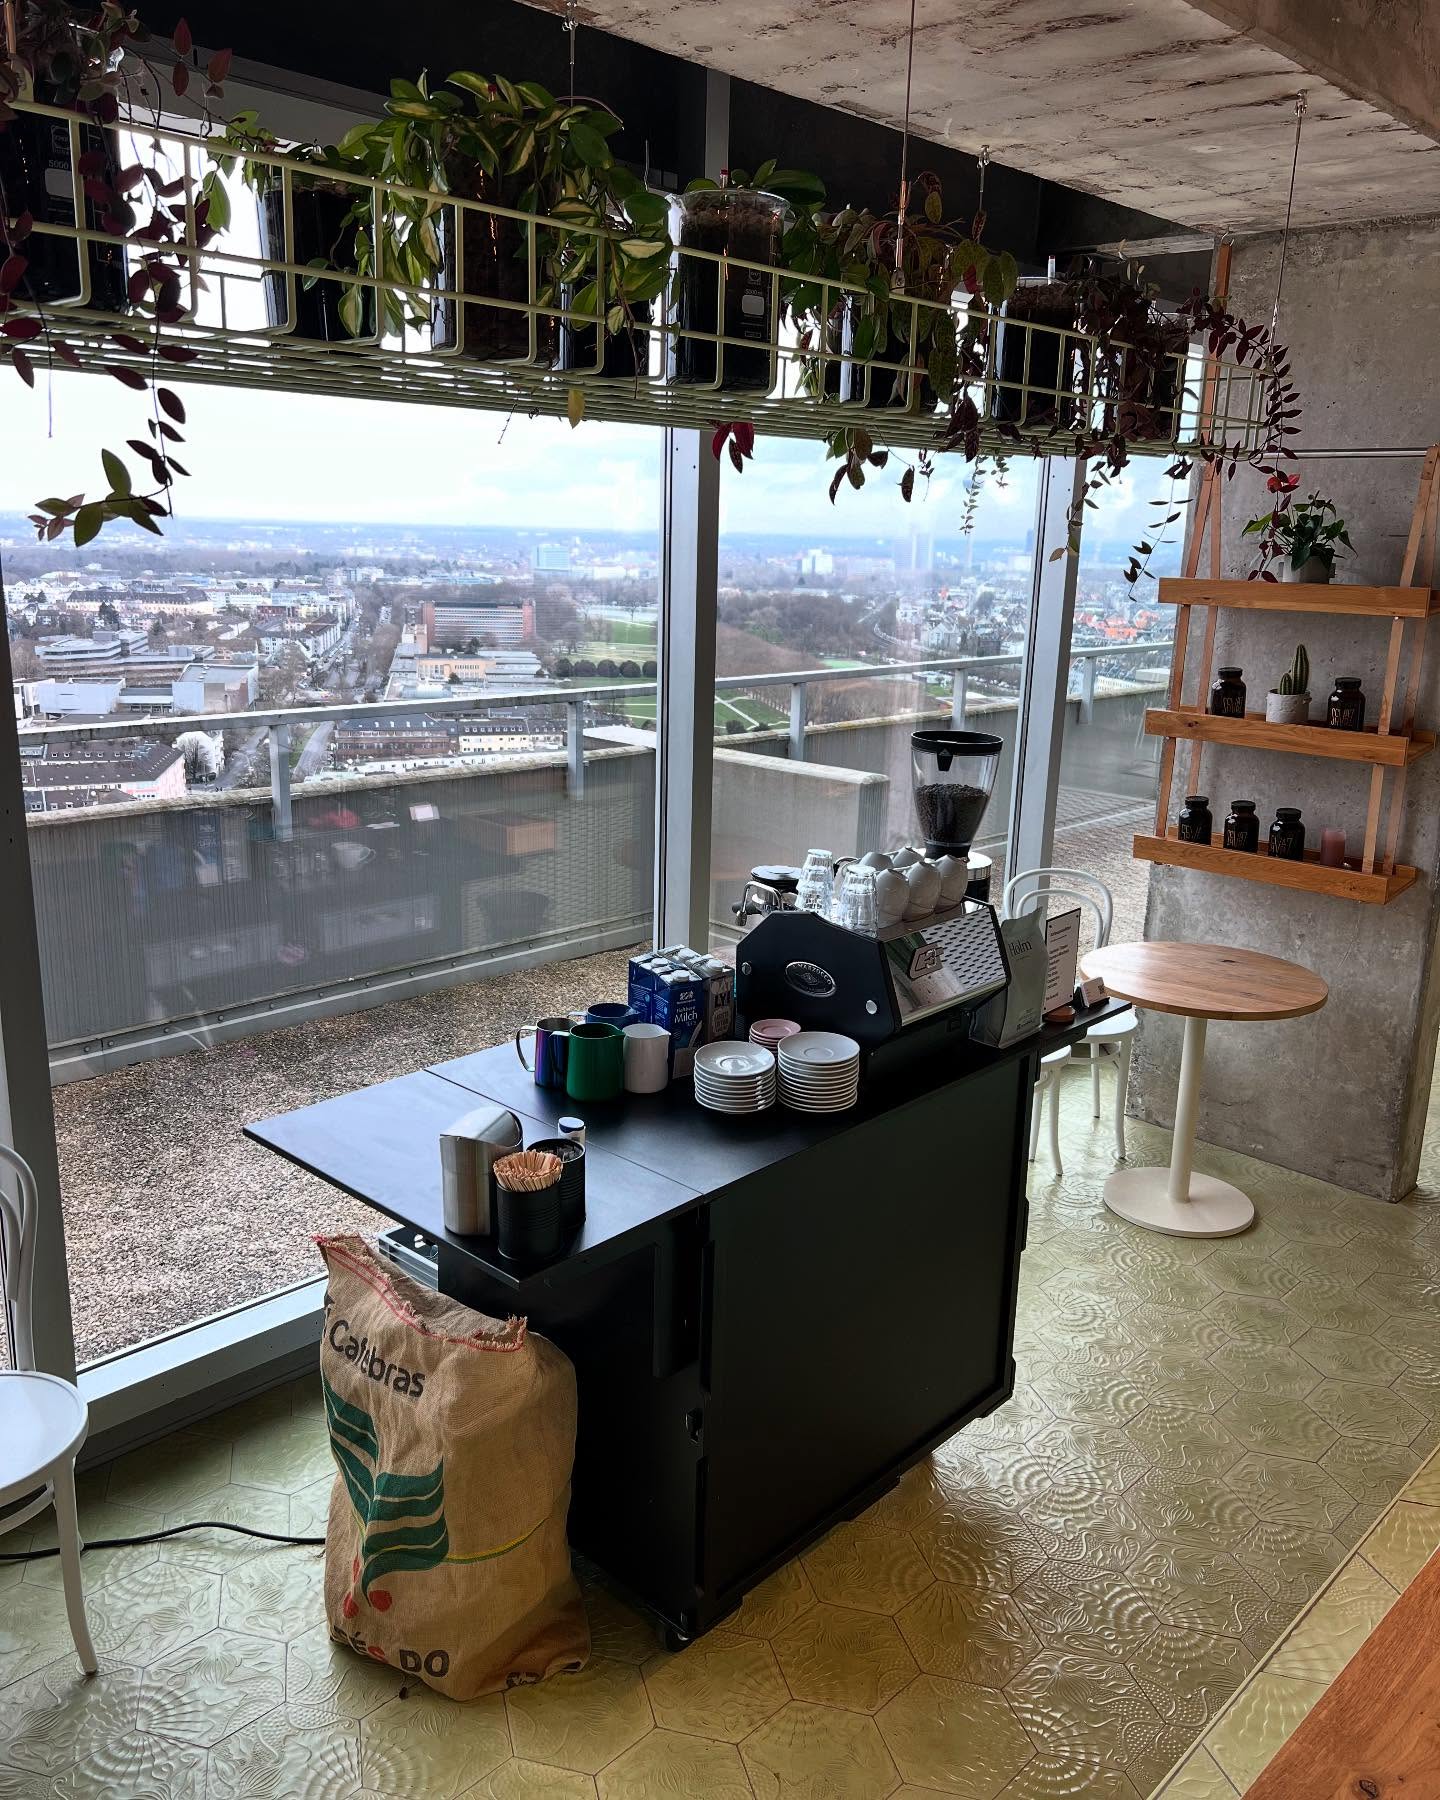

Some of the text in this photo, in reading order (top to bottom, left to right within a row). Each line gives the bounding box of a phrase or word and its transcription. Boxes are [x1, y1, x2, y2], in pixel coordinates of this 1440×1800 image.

[1008, 939, 1032, 958] Holm
[674, 1010, 698, 1024] Milch
[399, 1649, 450, 1678] DO
